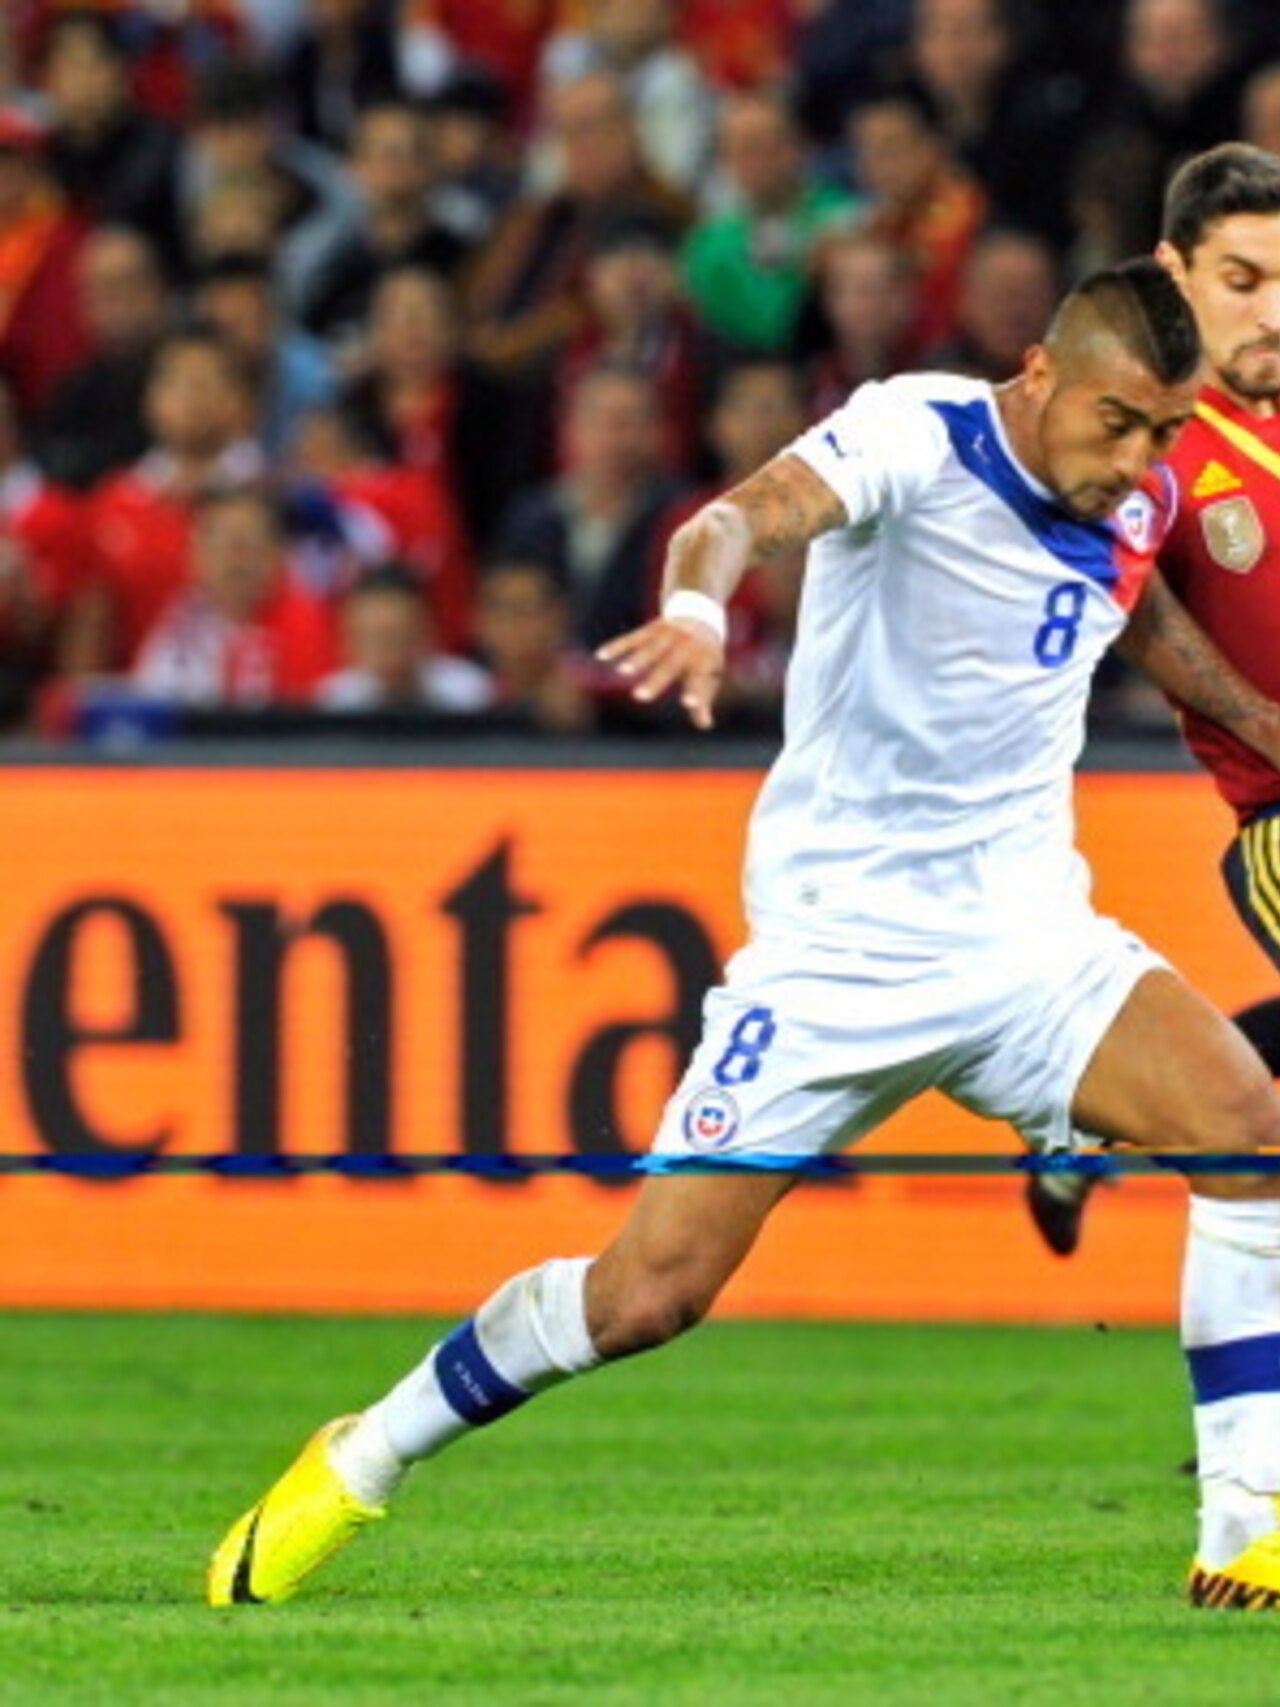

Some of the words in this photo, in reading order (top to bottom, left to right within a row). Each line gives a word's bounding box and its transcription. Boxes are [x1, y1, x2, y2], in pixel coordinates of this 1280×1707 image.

[1033, 581, 1086, 667] 8
[22, 836, 860, 1186] enta
[713, 1007, 776, 1086] 8
